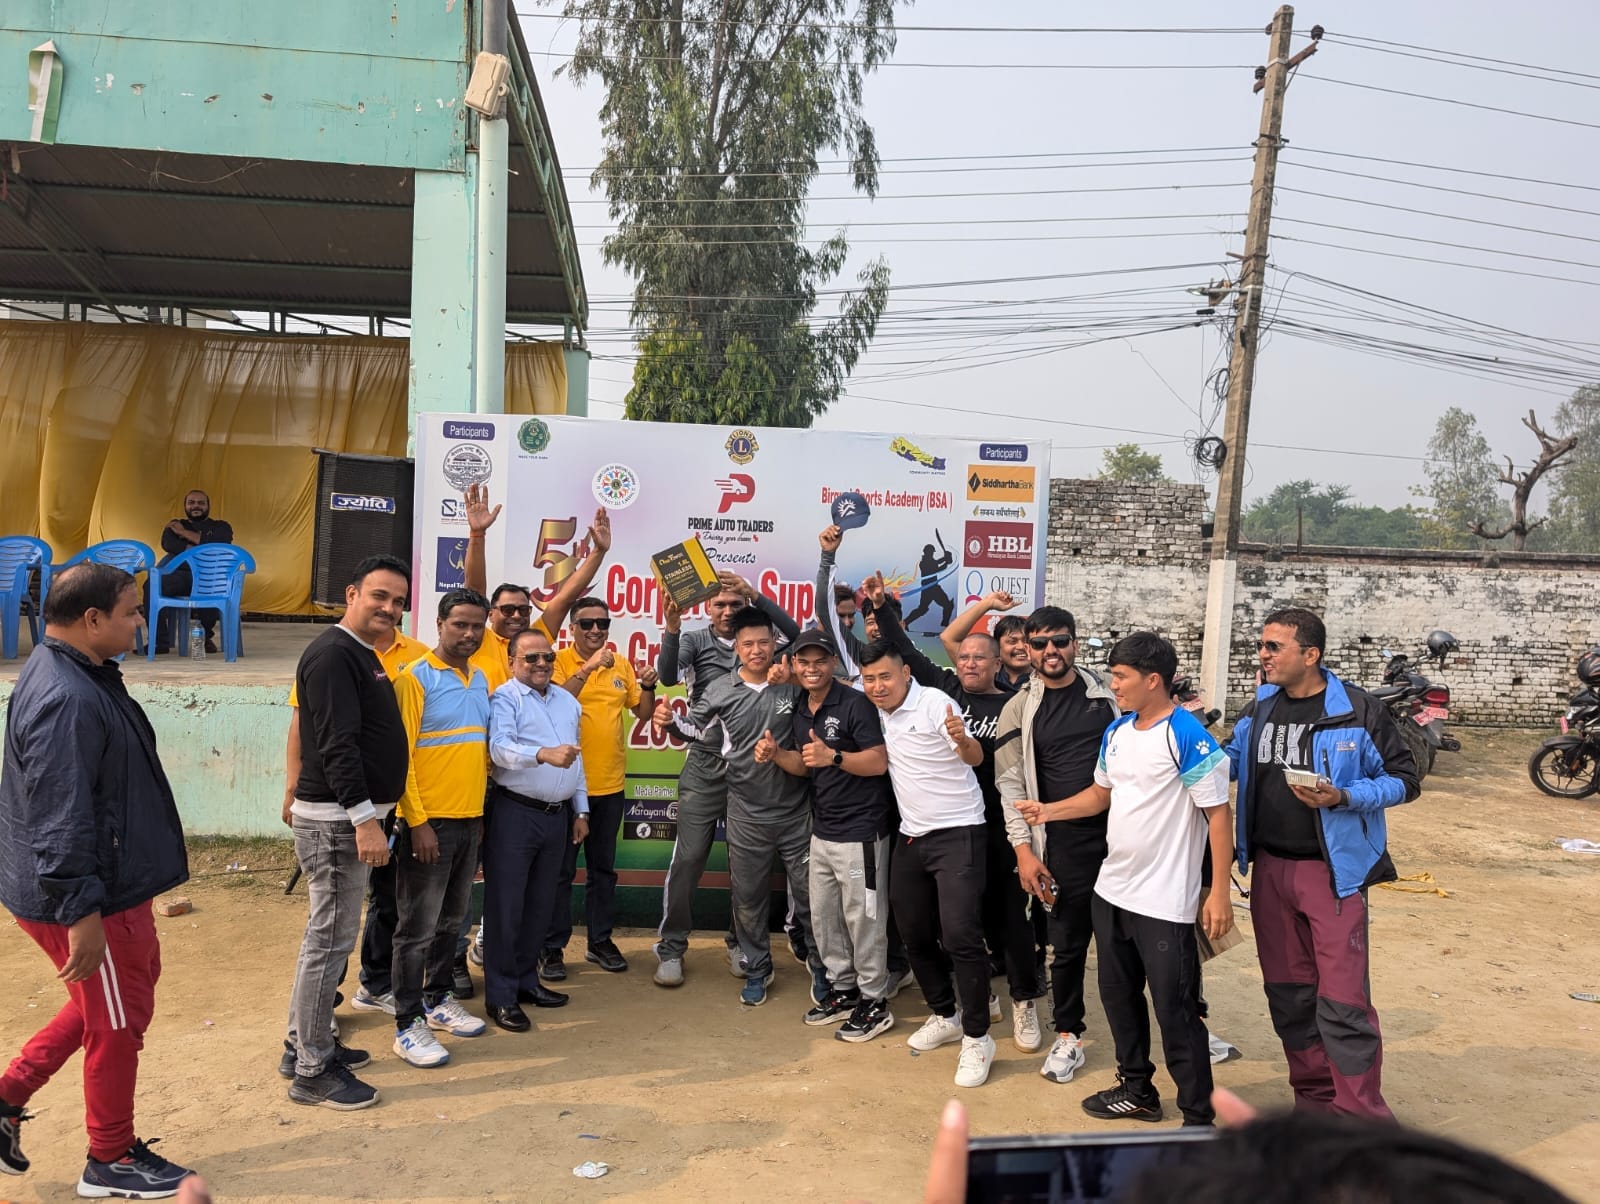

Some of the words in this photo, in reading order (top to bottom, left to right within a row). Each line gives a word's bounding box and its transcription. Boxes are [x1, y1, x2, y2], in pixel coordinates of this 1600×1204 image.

[450, 425, 489, 439] Participants
[986, 447, 1022, 459] Participants
[885, 490, 924, 512] Academy
[688, 517, 713, 530] PRIME
[714, 518, 736, 532] AUTO
[737, 520, 774, 533] TRADERS
[987, 535, 1032, 553] HBL
[705, 547, 756, 564] Presents
[990, 575, 1030, 595] QUEST
[626, 804, 666, 819] Narayani
